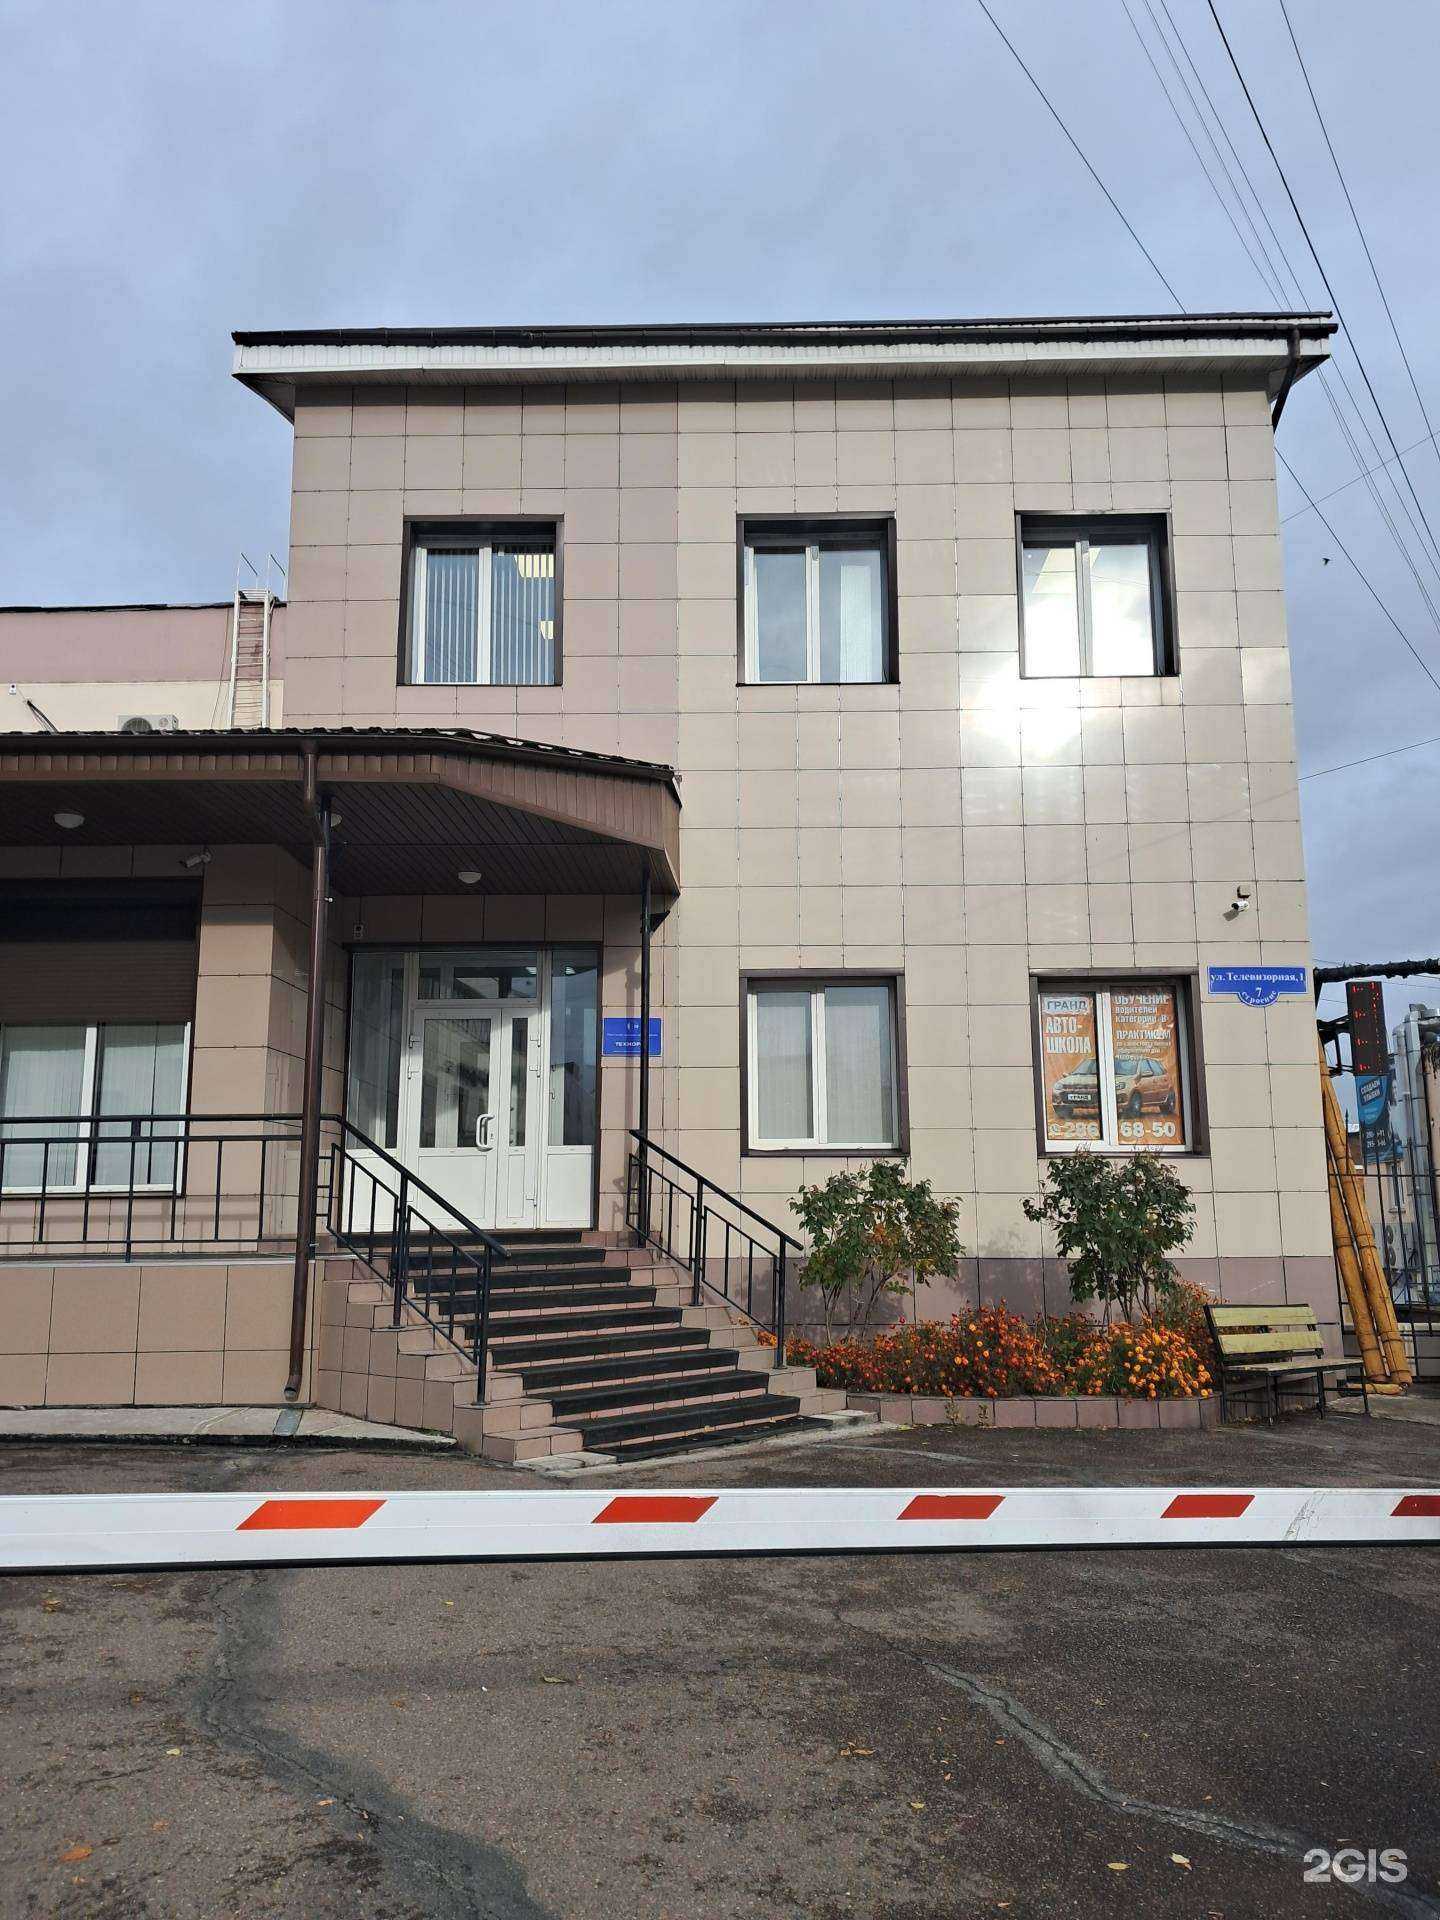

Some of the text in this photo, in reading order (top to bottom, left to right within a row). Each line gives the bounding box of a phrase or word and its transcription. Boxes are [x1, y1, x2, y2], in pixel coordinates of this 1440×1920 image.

[1210, 974, 1226, 984] ул.
[1255, 987, 1262, 998] 7
[1046, 1000, 1087, 1011] ГРАНД
[1046, 1016, 1083, 1034] АВТО-
[1046, 1036, 1092, 1054] ШКОЛА
[1063, 1121, 1176, 1138] 286 68-50
